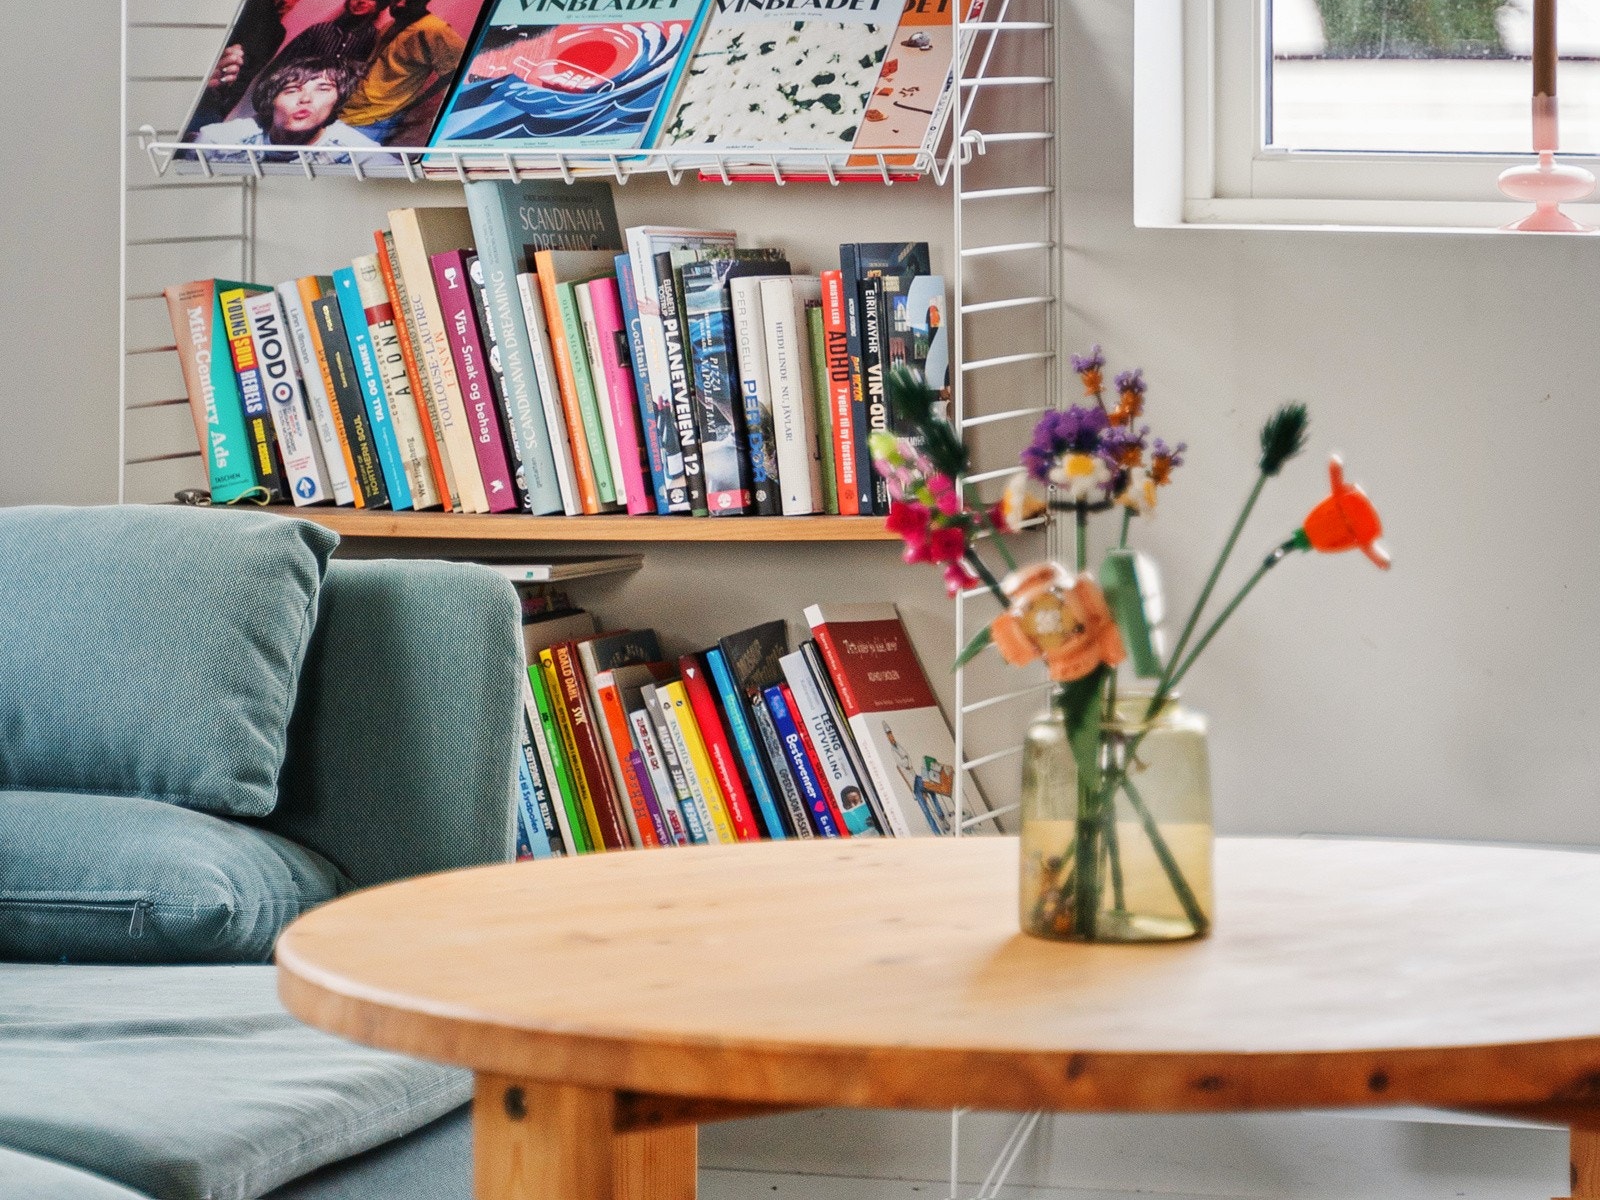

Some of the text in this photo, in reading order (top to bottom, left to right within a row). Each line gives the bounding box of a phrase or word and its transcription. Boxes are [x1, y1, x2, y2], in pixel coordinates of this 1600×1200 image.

[520, 206, 606, 232] SCANDINAVIA
[532, 232, 598, 251] DREAMING
[490, 270, 517, 348] DREAMING
[658, 285, 667, 316] TOSTRUP
[829, 280, 838, 306] KRISTIN
[290, 308, 301, 327] Linn
[736, 290, 752, 372] PER FUGELLI
[865, 290, 877, 352] EIRIK MYHR
[225, 297, 264, 413] YOUNG SOUL REBELS
[255, 314, 287, 380] MOD
[357, 342, 374, 377] TANKE
[374, 334, 385, 364] STAND
[378, 319, 410, 397] ALONE
[387, 248, 402, 281] INGER
[396, 283, 410, 315] ALVER
[420, 376, 443, 443] LYKKEHUSET
[434, 331, 456, 388] MANET
[630, 318, 647, 377] Cocktails
[775, 321, 787, 380] HEIDI LINDE
[828, 330, 849, 381] ADHD
[184, 306, 222, 425] Mid-Century
[210, 429, 230, 468] Ads
[367, 379, 379, 395] OG
[383, 372, 397, 415] COURAGE
[453, 309, 493, 442] Vin Smak og behag
[700, 358, 716, 433] NAPOLETANA
[709, 357, 720, 391] PIZZA
[371, 397, 385, 421] TALL
[507, 349, 537, 449] SCANDINAVIA
[663, 318, 698, 475] PLANETVEIEN 12
[743, 379, 759, 424] PER
[838, 395, 847, 415] veier
[320, 422, 331, 443] 1983
[839, 417, 848, 427] til
[839, 429, 848, 438] ny
[351, 414, 380, 494] NORTHERN SOUL
[405, 437, 426, 497] Wei Jingsheng
[555, 648, 572, 676] ROALD
[563, 677, 579, 700] DAHL
[571, 705, 586, 725] SVK
[820, 712, 841, 750] LESING
[784, 733, 822, 799] Bestevenner
[814, 722, 842, 779] UTVIKLING
[686, 766, 697, 786] MOT
[778, 768, 801, 812] OPERASJON
[520, 782, 539, 833] til Sydpolen
[539, 802, 552, 830] JAKTEN
[684, 800, 703, 839] VERDENS
[694, 787, 709, 819] SYKKEL
